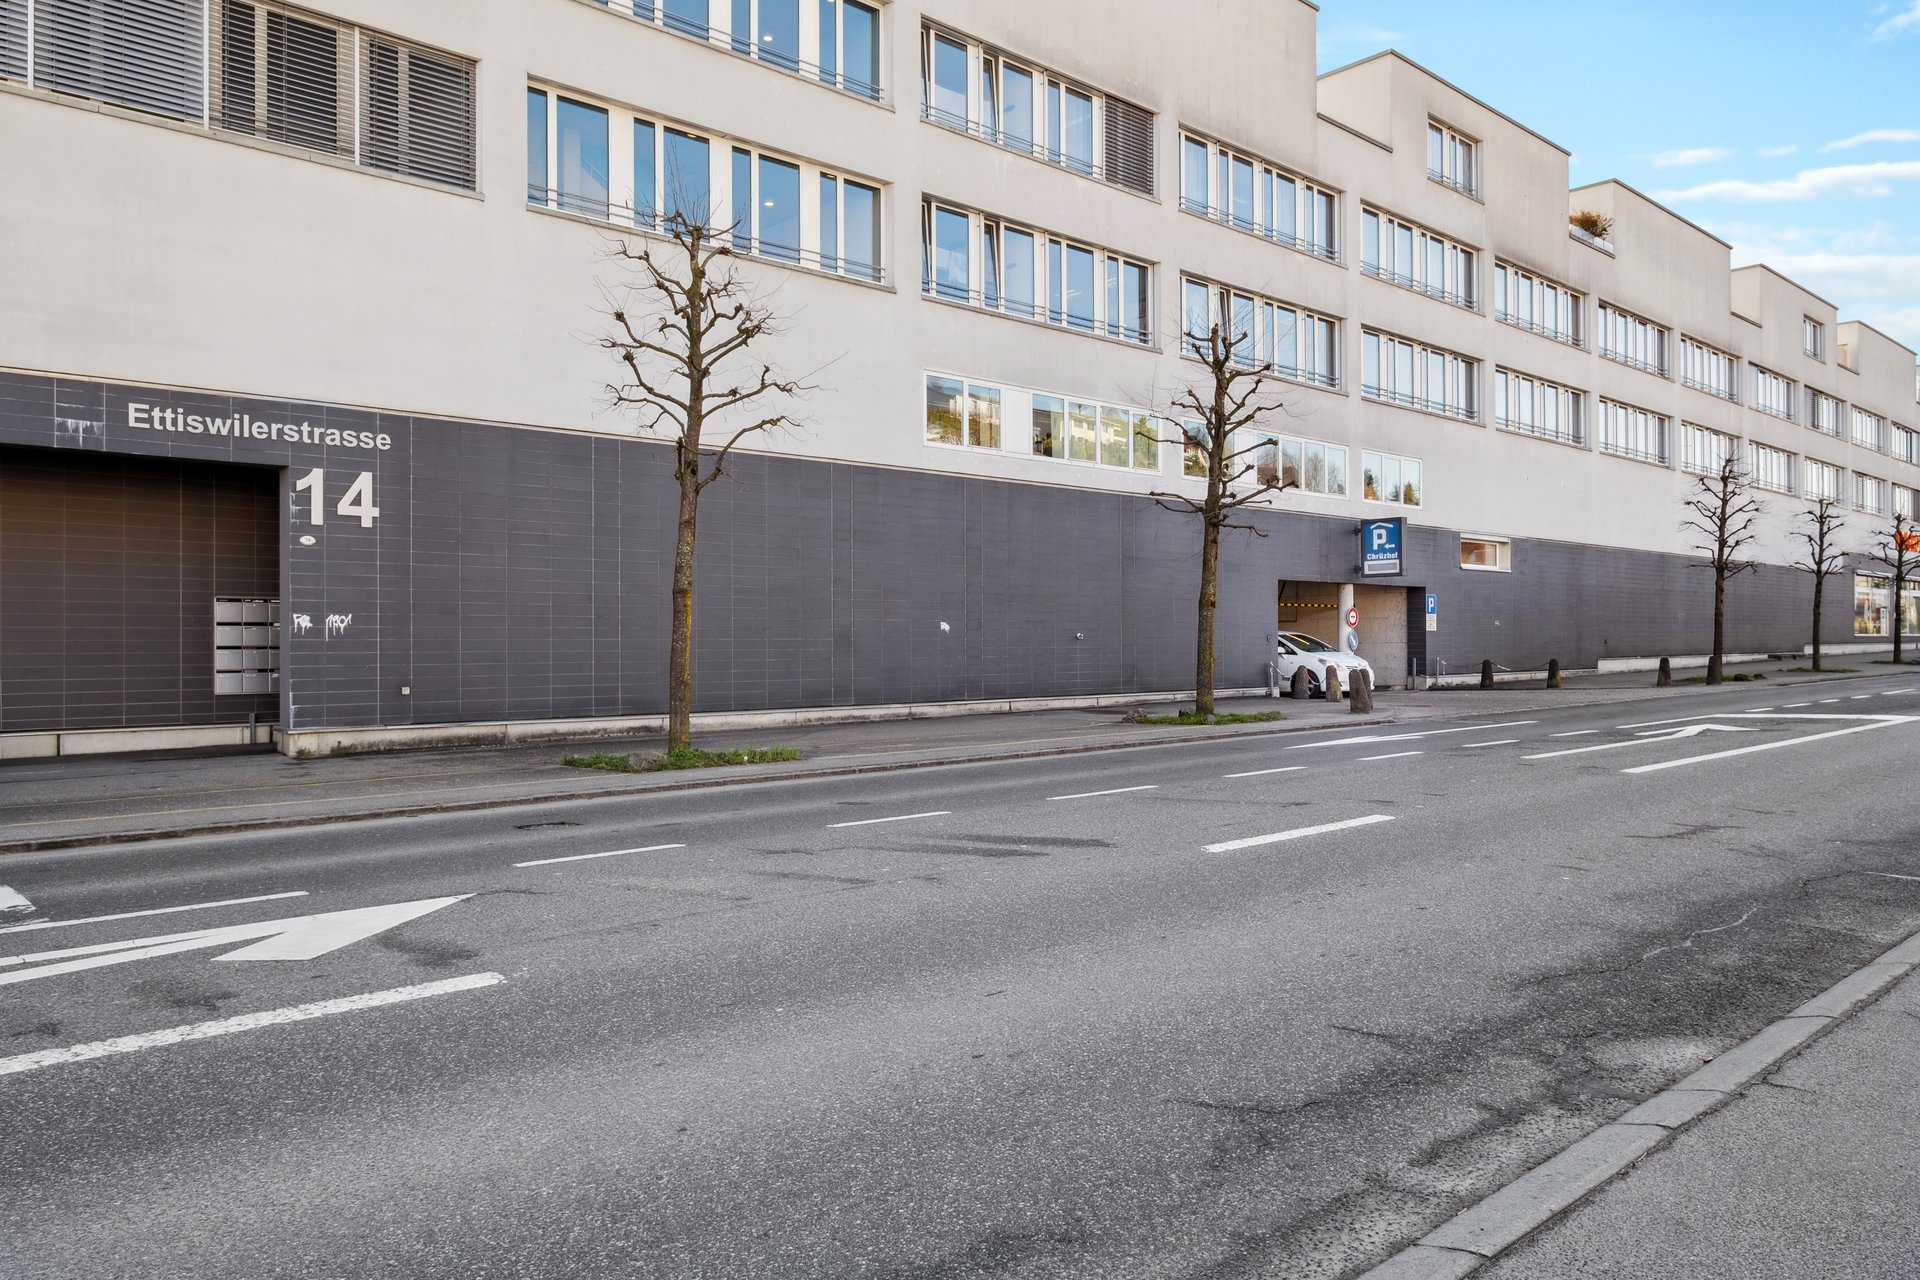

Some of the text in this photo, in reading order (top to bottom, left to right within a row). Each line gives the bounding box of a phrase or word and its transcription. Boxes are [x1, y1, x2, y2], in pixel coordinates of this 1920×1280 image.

[128, 402, 392, 450] Ettiswilerstrasse
[296, 468, 380, 528] 14
[1372, 529, 1387, 550] P
[1367, 552, 1398, 560] Chrüzhof
[1428, 597, 1434, 612] P
